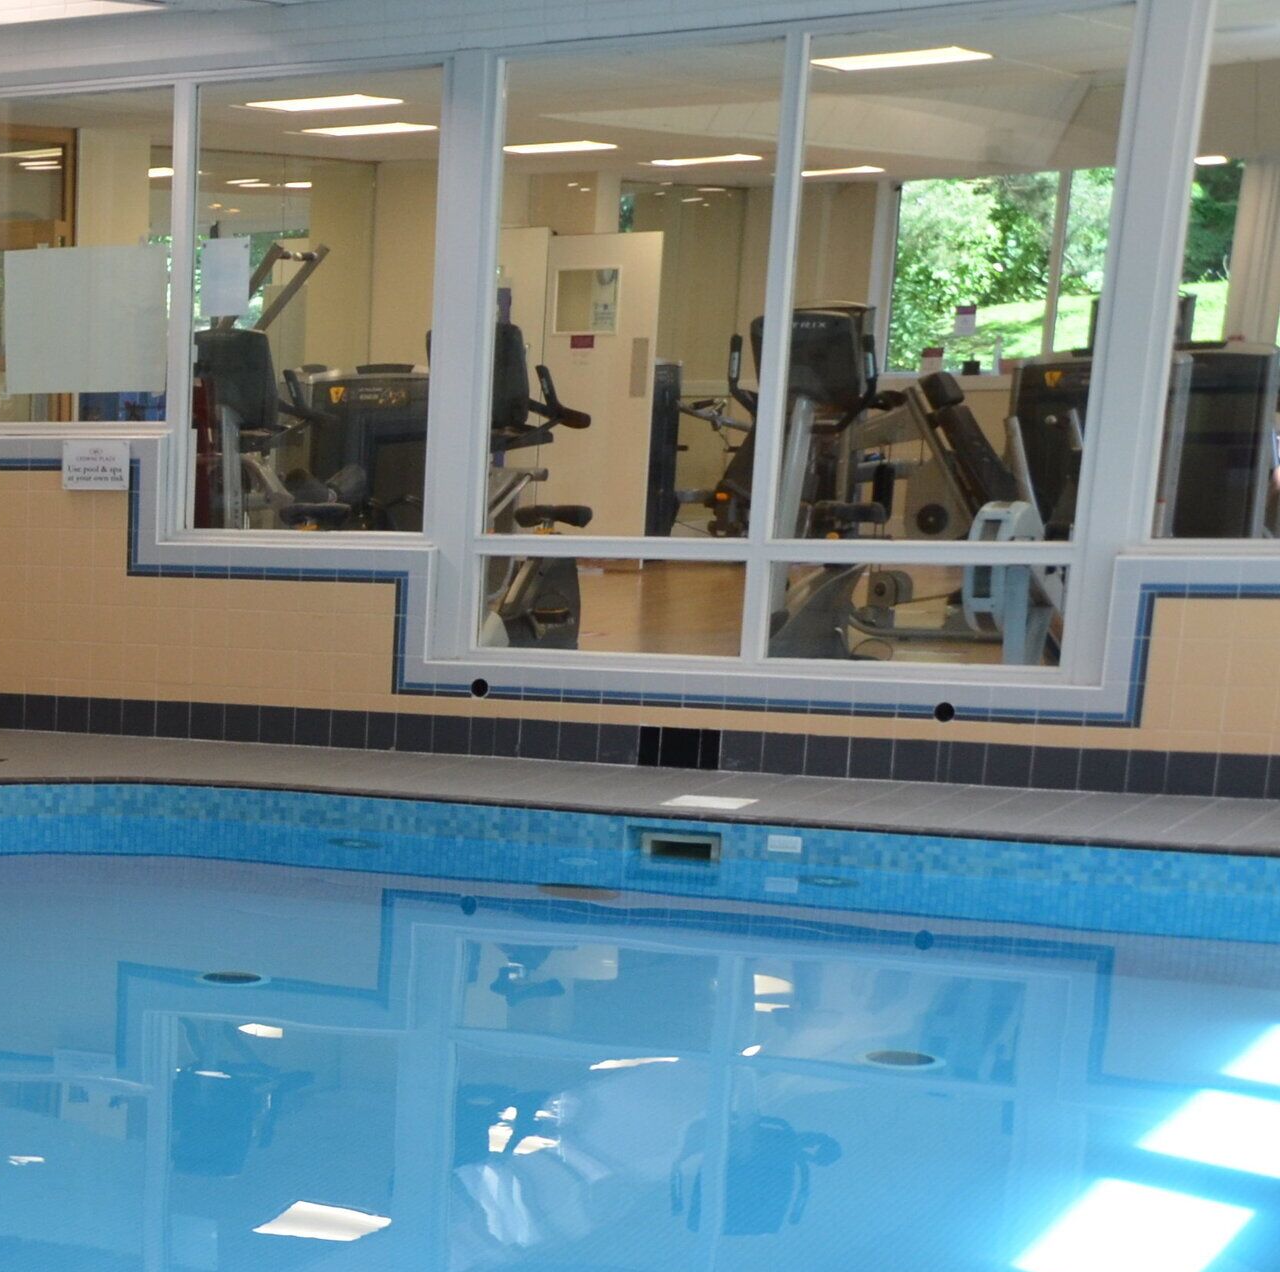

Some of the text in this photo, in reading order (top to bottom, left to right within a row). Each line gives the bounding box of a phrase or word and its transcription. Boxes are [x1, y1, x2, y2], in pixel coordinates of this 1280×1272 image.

[68, 464, 81, 473] Use
[83, 465, 99, 475] pool
[101, 465, 108, 473] &
